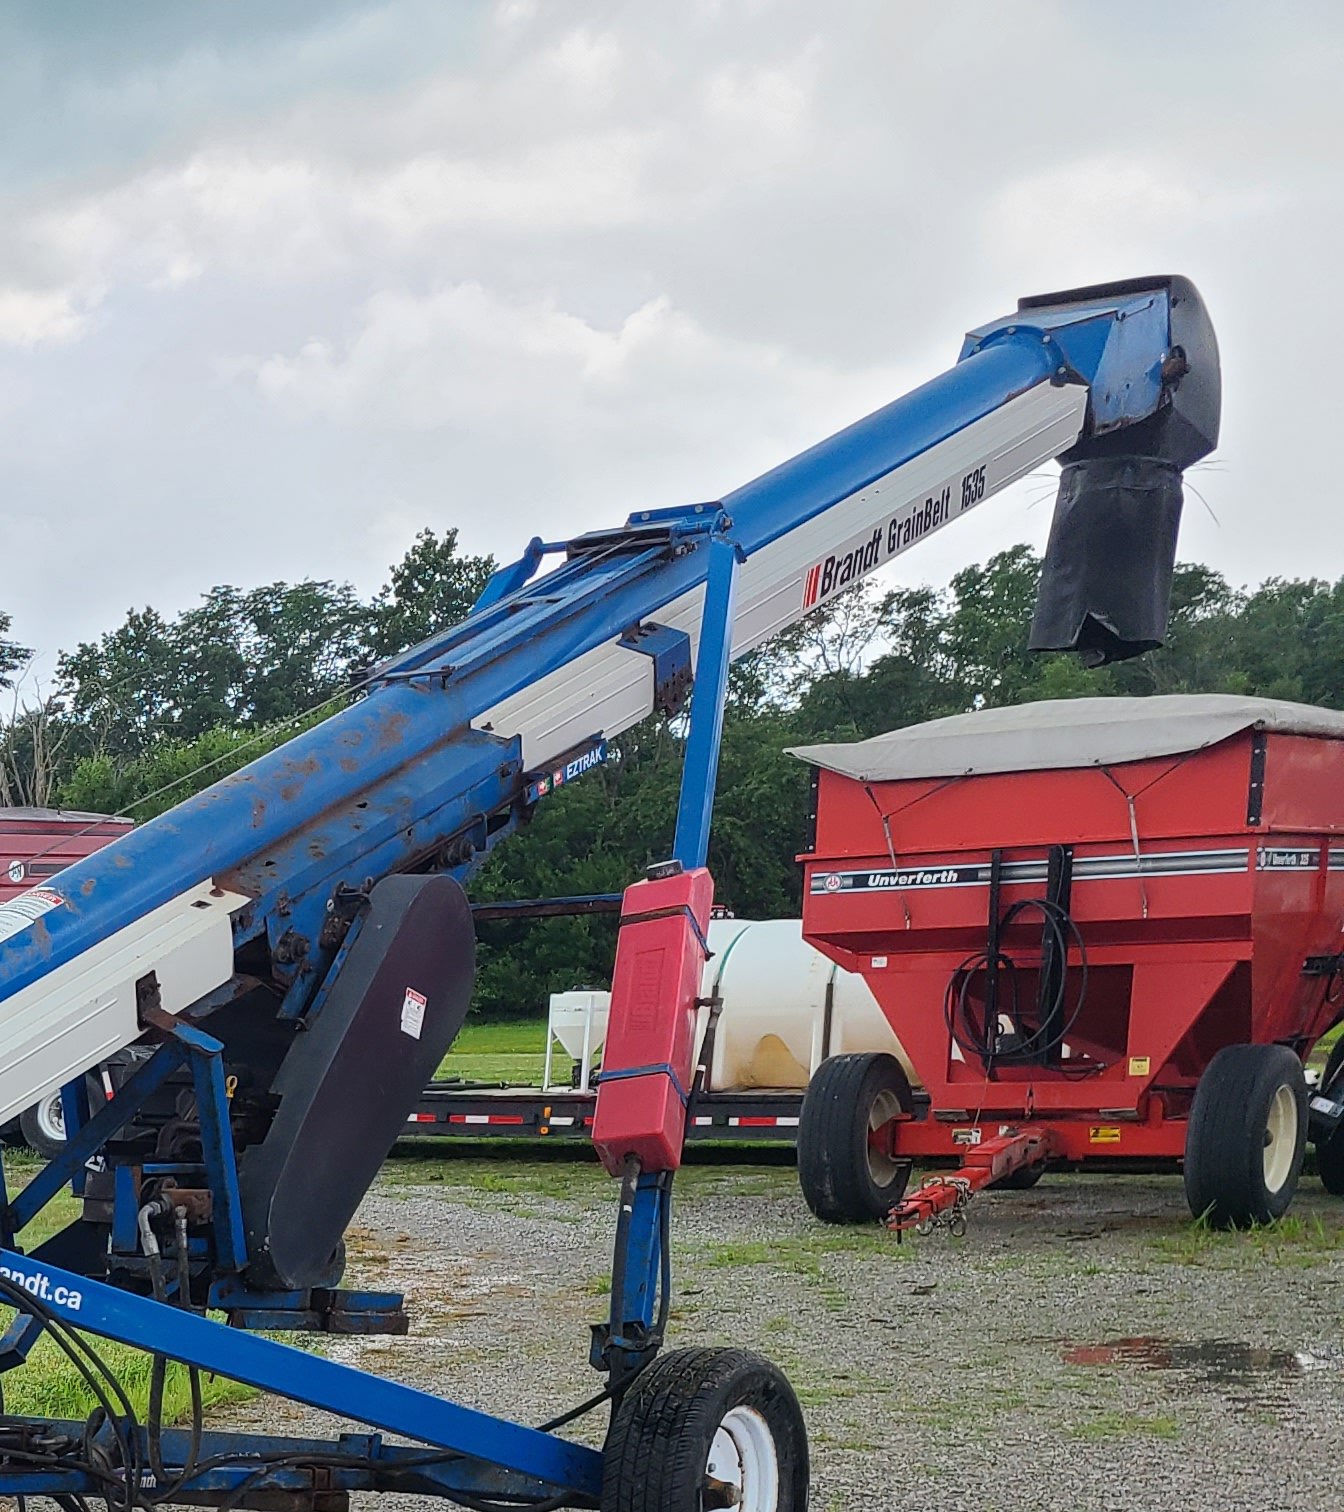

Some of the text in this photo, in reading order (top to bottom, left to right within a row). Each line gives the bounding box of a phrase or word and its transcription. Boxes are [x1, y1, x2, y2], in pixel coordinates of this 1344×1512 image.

[820, 464, 987, 598] Brandt GrainBelt 1535
[566, 746, 602, 780] EZTRAK
[868, 870, 958, 886] Unverferth
